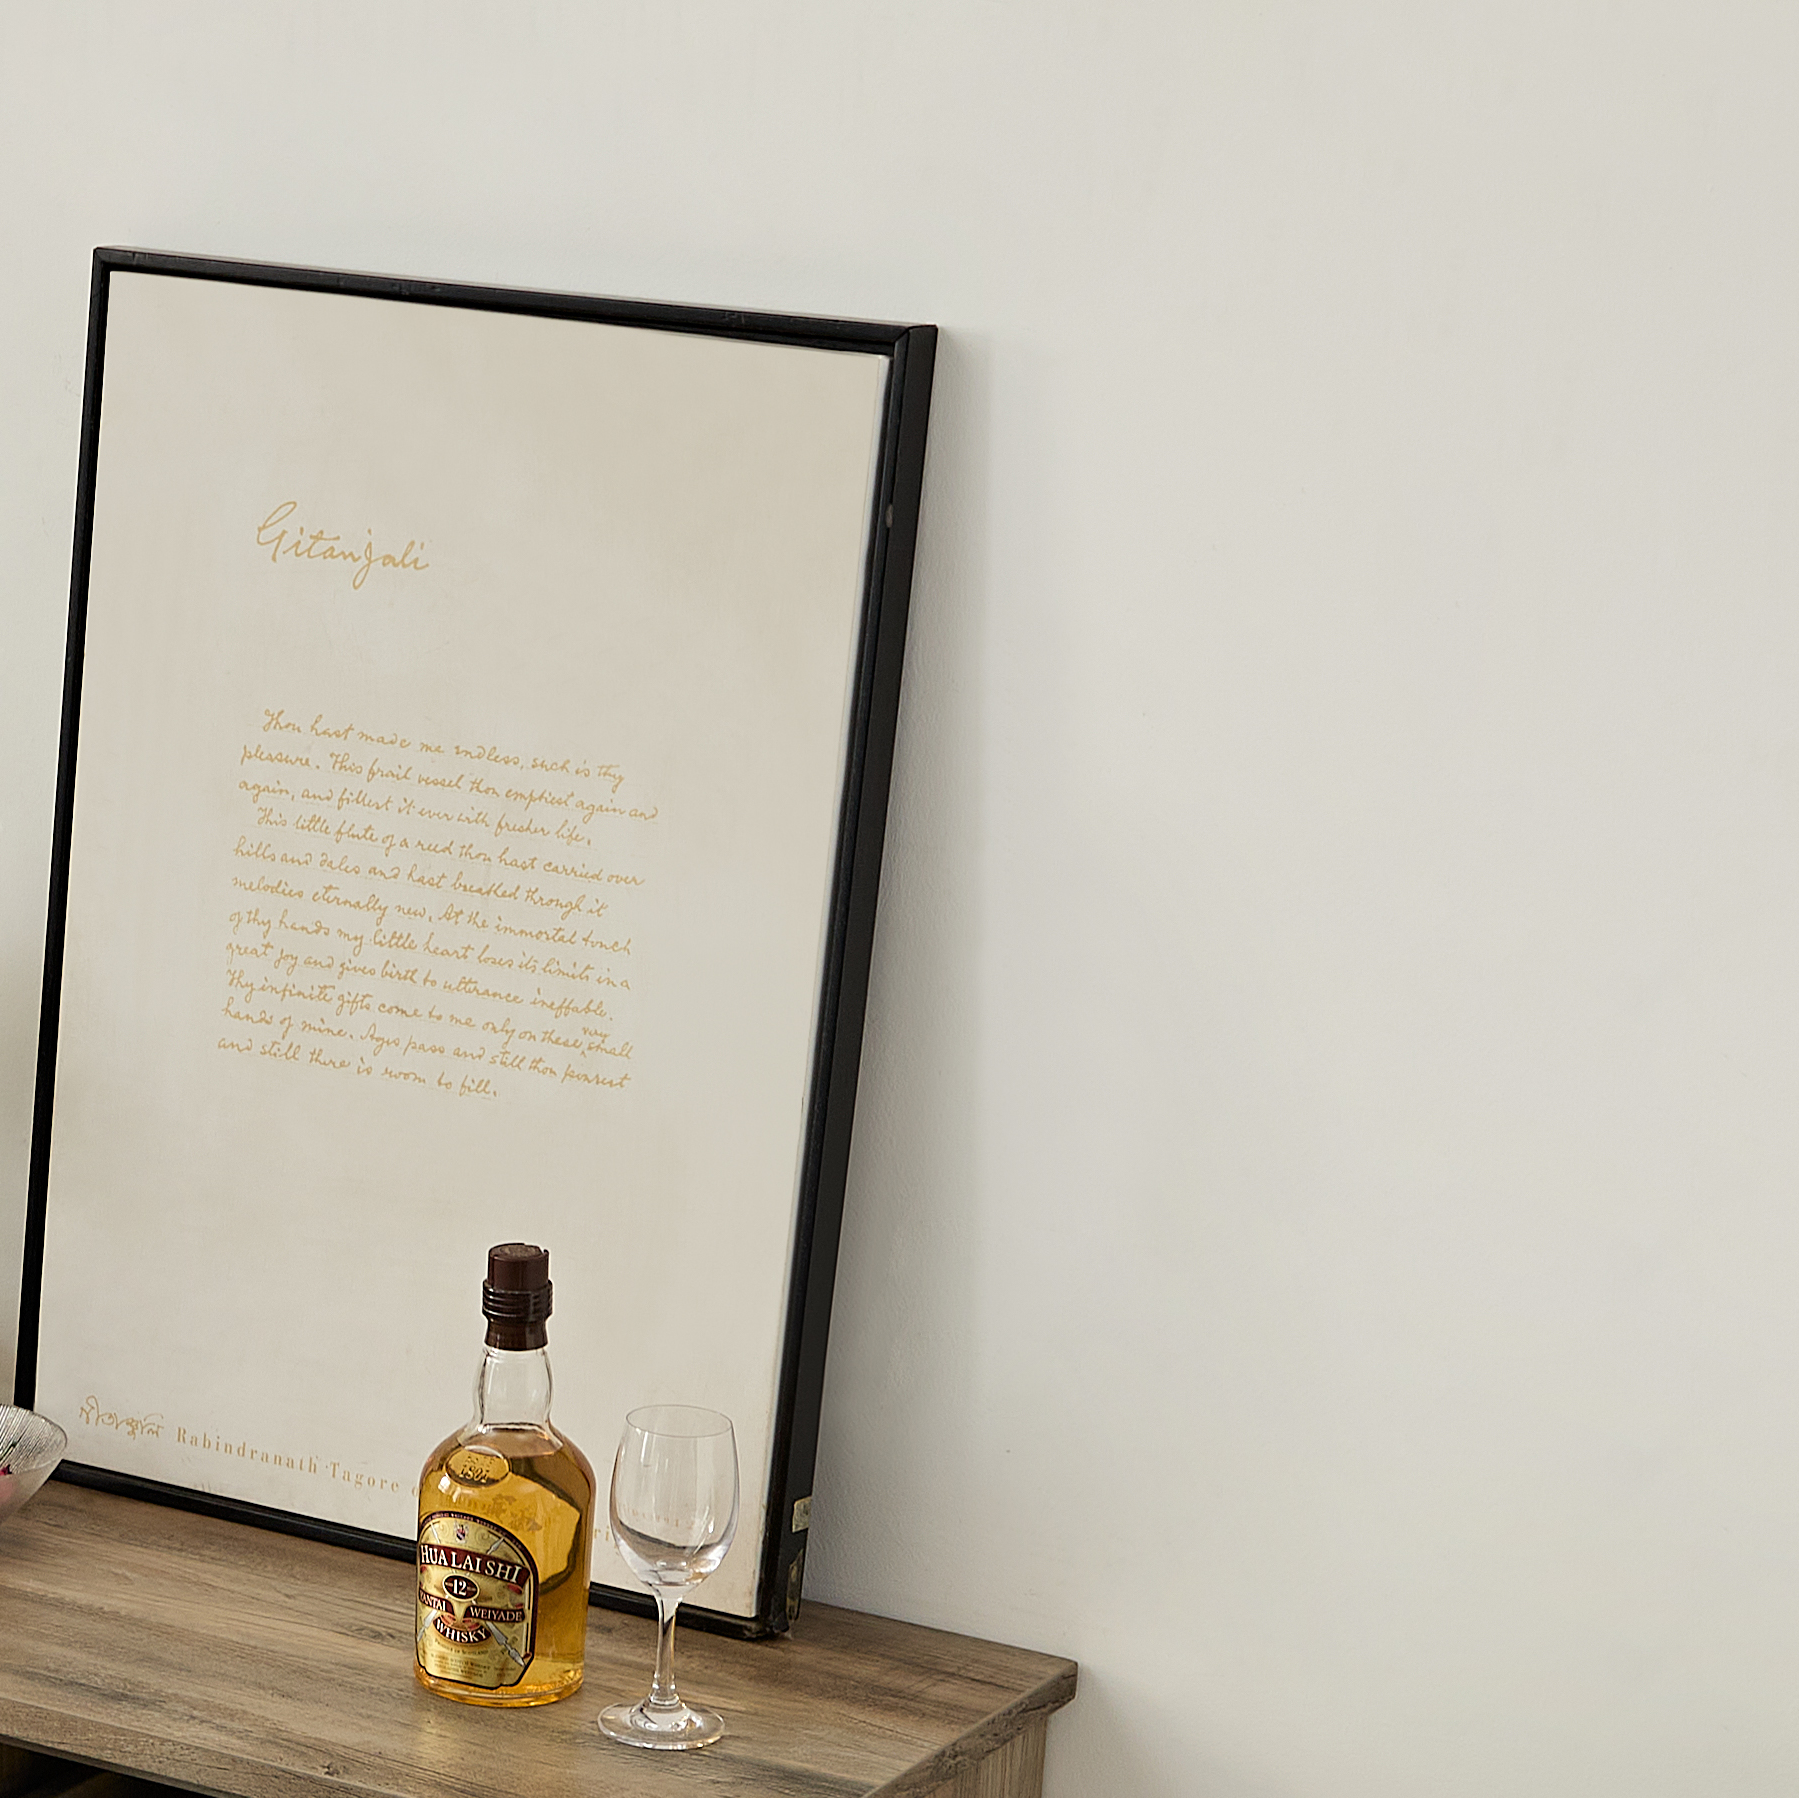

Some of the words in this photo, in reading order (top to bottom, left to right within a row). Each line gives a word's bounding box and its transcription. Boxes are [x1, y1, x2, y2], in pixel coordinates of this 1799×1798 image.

[257, 500, 429, 590] Gitanjali
[311, 714, 354, 740] hast
[357, 732, 411, 748] made
[420, 743, 444, 753] me
[531, 758, 570, 773] such
[575, 760, 590, 778] is
[598, 765, 624, 794] thy
[330, 752, 362, 774] This
[367, 758, 412, 783] frail
[418, 774, 464, 789] vessel
[505, 789, 574, 810] emptiest
[575, 799, 626, 824] again
[629, 807, 658, 820] and
[239, 780, 294, 804] again,
[301, 789, 333, 801] and
[337, 788, 393, 811] fillest
[398, 797, 415, 815] it
[418, 808, 454, 821] ever
[457, 807, 490, 827] with
[495, 813, 550, 837] fresher
[233, 835, 276, 862] hills
[281, 853, 312, 866] and
[320, 852, 360, 875] dales
[368, 867, 400, 880] and
[407, 864, 447, 889] hast
[451, 871, 520, 900] breathed
[525, 887, 586, 920] through
[587, 899, 608, 917] it
[258, 807, 287, 826] This
[294, 814, 331, 835] little
[334, 820, 378, 844] flute
[382, 834, 396, 857] of
[400, 838, 409, 848] a
[415, 840, 454, 855] reed
[498, 847, 538, 871] hast
[543, 862, 603, 882] carried
[607, 875, 644, 886] over
[229, 912, 243, 935] of
[247, 908, 271, 939] thy
[279, 909, 330, 936] hands
[337, 929, 364, 957] my
[374, 929, 417, 950] little
[423, 932, 474, 960] heart
[477, 944, 514, 968] loses
[542, 958, 594, 981] limits
[596, 968, 617, 987] in
[620, 980, 630, 990] a
[232, 876, 304, 899] melodies
[312, 884, 388, 926] eternally
[438, 903, 464, 925] At
[467, 911, 488, 929] the
[495, 916, 577, 945] immortal
[582, 930, 631, 955] touch
[226, 942, 274, 964] great
[274, 948, 298, 976] joy
[304, 956, 334, 969] and
[338, 959, 376, 980] gives
[381, 960, 418, 984] birth
[423, 970, 437, 987] to
[222, 996, 273, 1025] hands
[280, 1016, 294, 1040] of
[302, 1018, 353, 1040] mine.
[403, 1036, 445, 1056] pass
[453, 1047, 486, 1060] and
[489, 1050, 526, 1071] still
[227, 969, 256, 1004] Thy
[258, 977, 336, 1003] infinite
[336, 992, 373, 1016] gifts
[378, 1003, 422, 1018] come
[429, 1005, 442, 1021] to
[450, 1014, 476, 1028] me
[482, 1018, 516, 1049] only
[518, 1031, 536, 1042] on
[587, 1042, 633, 1059] small
[218, 1038, 252, 1053] and
[260, 1041, 301, 1061] still
[309, 1048, 350, 1069] there
[357, 1057, 372, 1076] is
[382, 1067, 426, 1084] room
[437, 1072, 452, 1090] to
[176, 1426, 318, 1475] Rabindranath
[330, 1461, 400, 1493] Tagore
[453, 1579, 467, 1597] 12
[470, 1606, 522, 1621] WEIYADE
[435, 1616, 487, 1644] WHISKY
